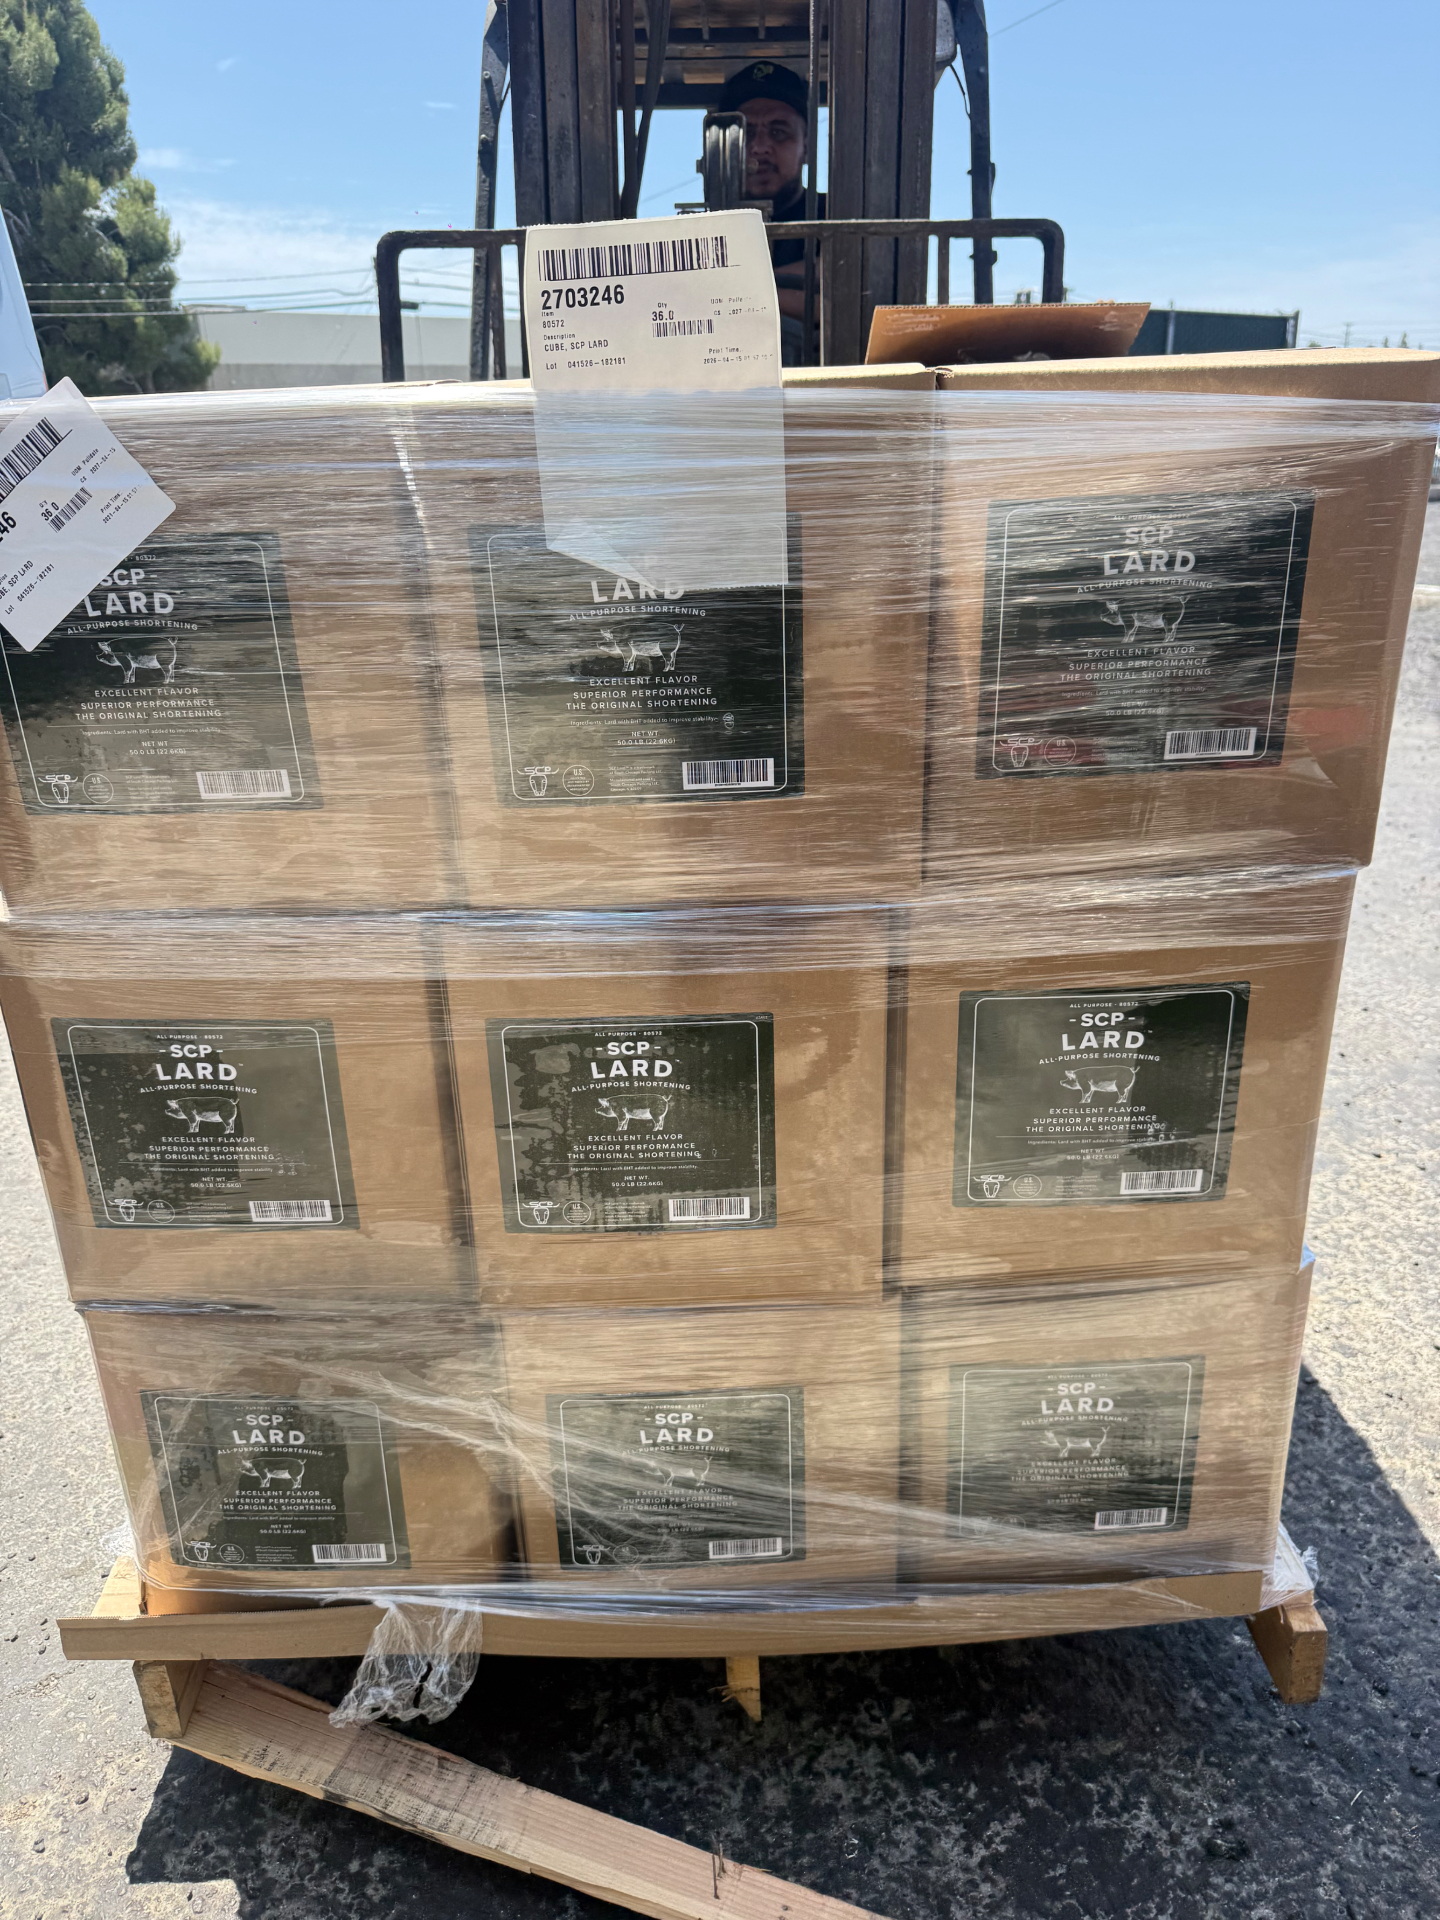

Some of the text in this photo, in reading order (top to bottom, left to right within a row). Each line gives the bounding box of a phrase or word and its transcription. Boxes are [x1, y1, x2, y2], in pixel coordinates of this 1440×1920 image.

[542, 284, 624, 310] 2703246
[652, 310, 674, 321] 36.0
[543, 320, 564, 328] 80572
[544, 340, 608, 352] CUBE, SCP LARD
[568, 357, 626, 369] 041526-182181
[1124, 526, 1174, 544] SCP
[1103, 551, 1196, 575] LARD
[8, 574, 19, 586] SCP
[19, 560, 34, 577] LARD
[100, 568, 145, 586] SCP
[591, 578, 685, 602] LARD
[1077, 578, 1213, 593] ALL-PURPOSE SHORTENING
[5, 605, 15, 615] Lot
[84, 592, 174, 617] LARD
[570, 606, 706, 621] ALL-PURPOSE SHORTENING
[68, 620, 198, 634] ALL-PURPOSE SHORTENING
[1088, 646, 1195, 657] EXCELLENT FLAVOR
[1068, 658, 1207, 670] SUPERIOR PERFORMANCE
[1085, 671, 1137, 681] ORIGINAL
[1141, 669, 1211, 679] SHORTENING
[590, 677, 650, 686] EXCELLENT
[94, 689, 152, 698] EXCELLENT
[573, 688, 712, 699] SUPERIOR PERFORMANCE
[81, 701, 132, 710] SUPERIOR
[591, 700, 642, 709] ORIGINAL
[647, 698, 717, 707] SHORTENING
[100, 711, 148, 719] ORIGINAL
[153, 710, 222, 718] SHORTENING
[1081, 1012, 1124, 1026] SCP
[1062, 1031, 1144, 1050] LARD
[170, 1044, 212, 1058] SCP
[607, 1042, 650, 1055] SCP
[1039, 1053, 1160, 1064] ALL-PURPOSE SHORTENING
[156, 1062, 238, 1080] LARD
[591, 1060, 673, 1079] LARD
[140, 1084, 257, 1094] ALL-PURPOSE SHORTENING
[571, 1081, 690, 1092] ALL-PURPOSE SHORTENING
[1098, 1123, 1160, 1131] SHORTENING
[1058, 1382, 1096, 1395] SCP
[1041, 1398, 1114, 1414] LARD
[246, 1415, 284, 1425] SCP
[655, 1413, 694, 1424] SCP
[1021, 1416, 1074, 1426] ALL-PURPOSE
[233, 1430, 306, 1444] LARD
[640, 1428, 714, 1444] LARD
[218, 1447, 323, 1455] ALL-PURPOSE SHORTENING
